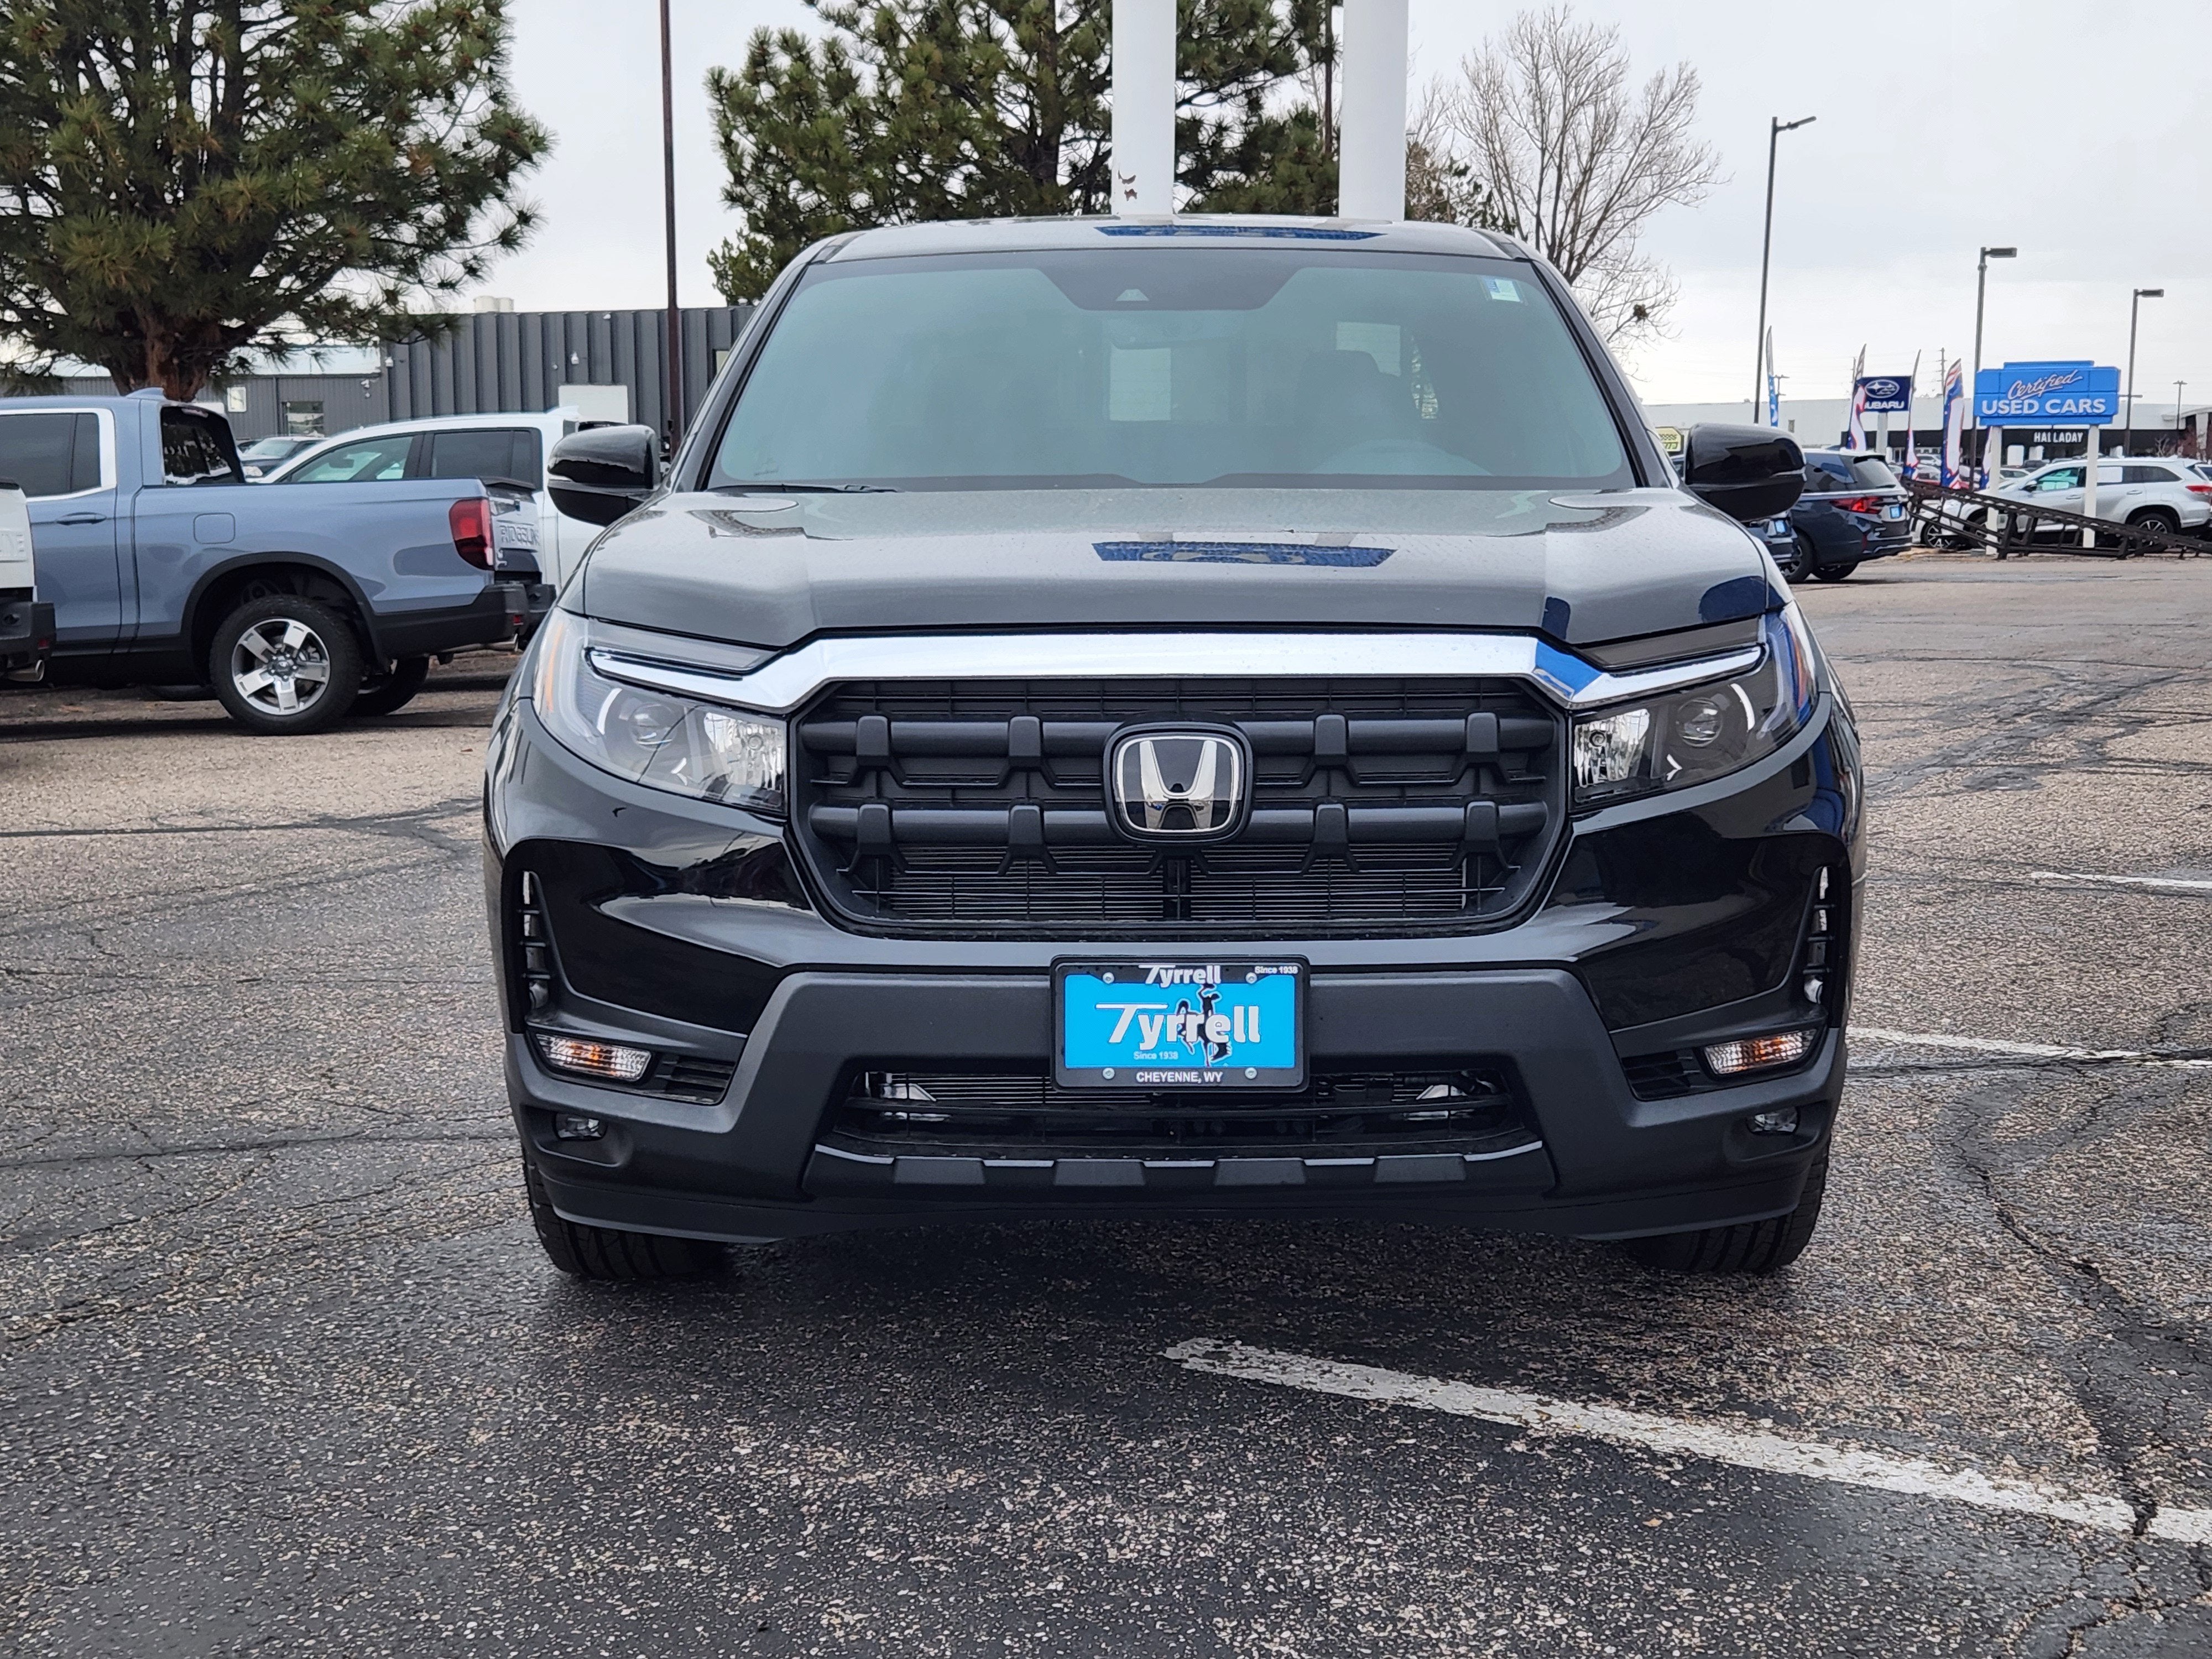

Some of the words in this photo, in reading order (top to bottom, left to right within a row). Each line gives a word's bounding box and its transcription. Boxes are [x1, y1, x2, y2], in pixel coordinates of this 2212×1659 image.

[2007, 369, 2083, 399] Certified
[1982, 399, 2039, 414] USED
[2046, 398, 2106, 414] CARS
[1138, 964, 1221, 988] Tyrrell
[1254, 966, 1276, 974] Since
[1095, 1004, 1260, 1050] Tyrrell
[1133, 1051, 1157, 1060] Since
[1159, 1051, 1178, 1060] 1938
[1136, 1071, 1201, 1084] CHEYENNE,
[1203, 1072, 1223, 1082] WY
